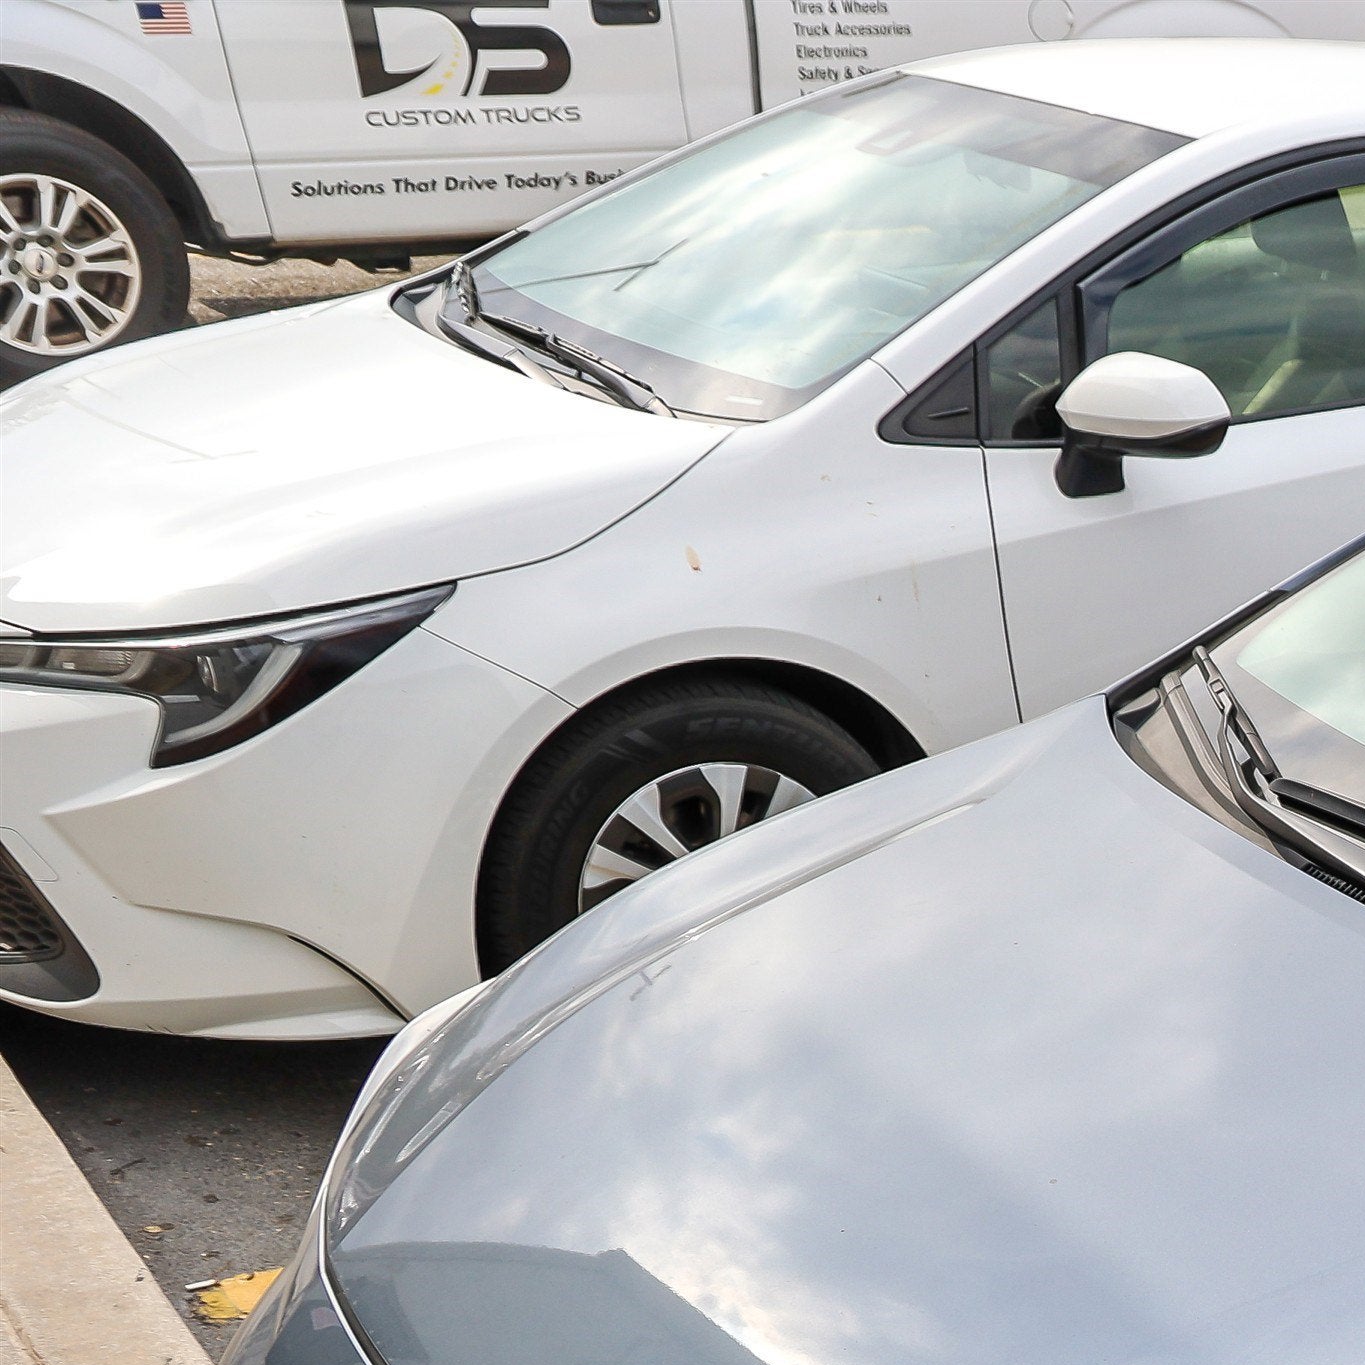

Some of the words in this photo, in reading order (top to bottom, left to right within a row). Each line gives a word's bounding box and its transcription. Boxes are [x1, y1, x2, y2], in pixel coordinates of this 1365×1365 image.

[792, 0, 823, 14] Tires
[828, 1, 838, 13] &
[843, 0, 889, 13] Wheels
[793, 22, 829, 36] Truck
[835, 21, 912, 36] Accessories
[796, 44, 869, 59] Electronics
[798, 66, 839, 81] Safety
[844, 67, 854, 80] &
[365, 108, 476, 127] CUSTOM
[480, 105, 582, 124] TRUCKS
[291, 180, 386, 197] Solutions
[392, 176, 437, 193] That
[444, 175, 498, 191] Drive
[504, 171, 579, 191] Today's
